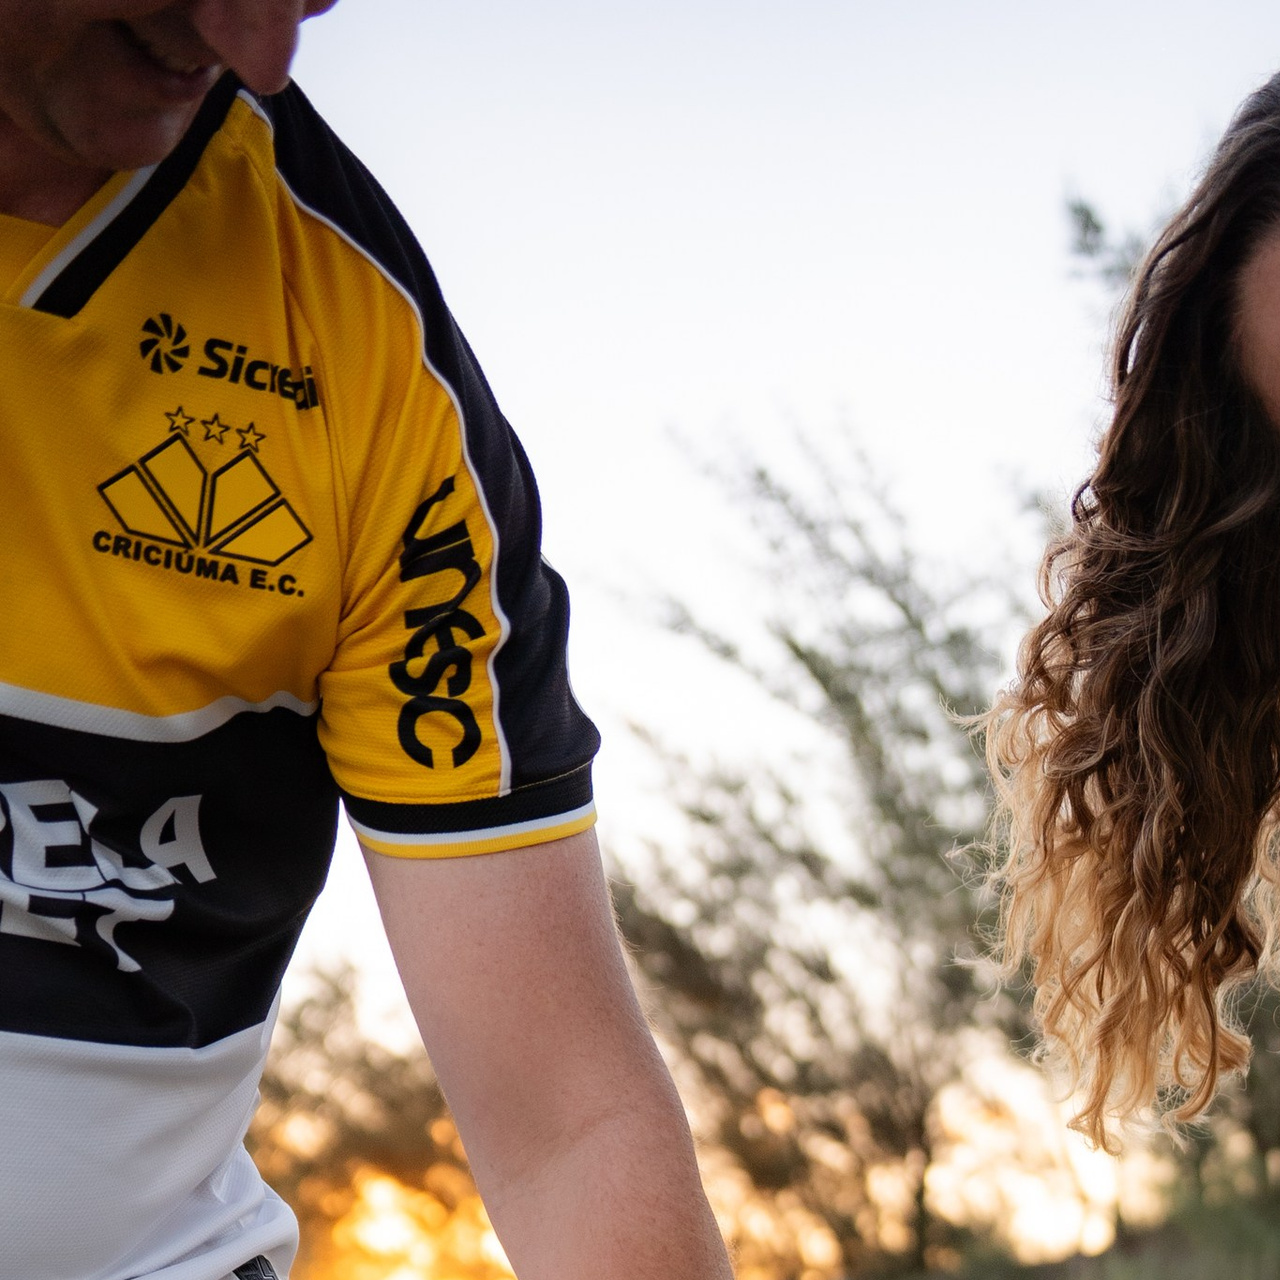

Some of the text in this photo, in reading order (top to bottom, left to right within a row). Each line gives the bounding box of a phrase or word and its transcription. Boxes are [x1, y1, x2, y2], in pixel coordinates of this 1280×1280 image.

[92, 531, 304, 597] CRICIÚMA E.C.
[389, 475, 486, 769] unesc
[0, 779, 217, 891] ELA
